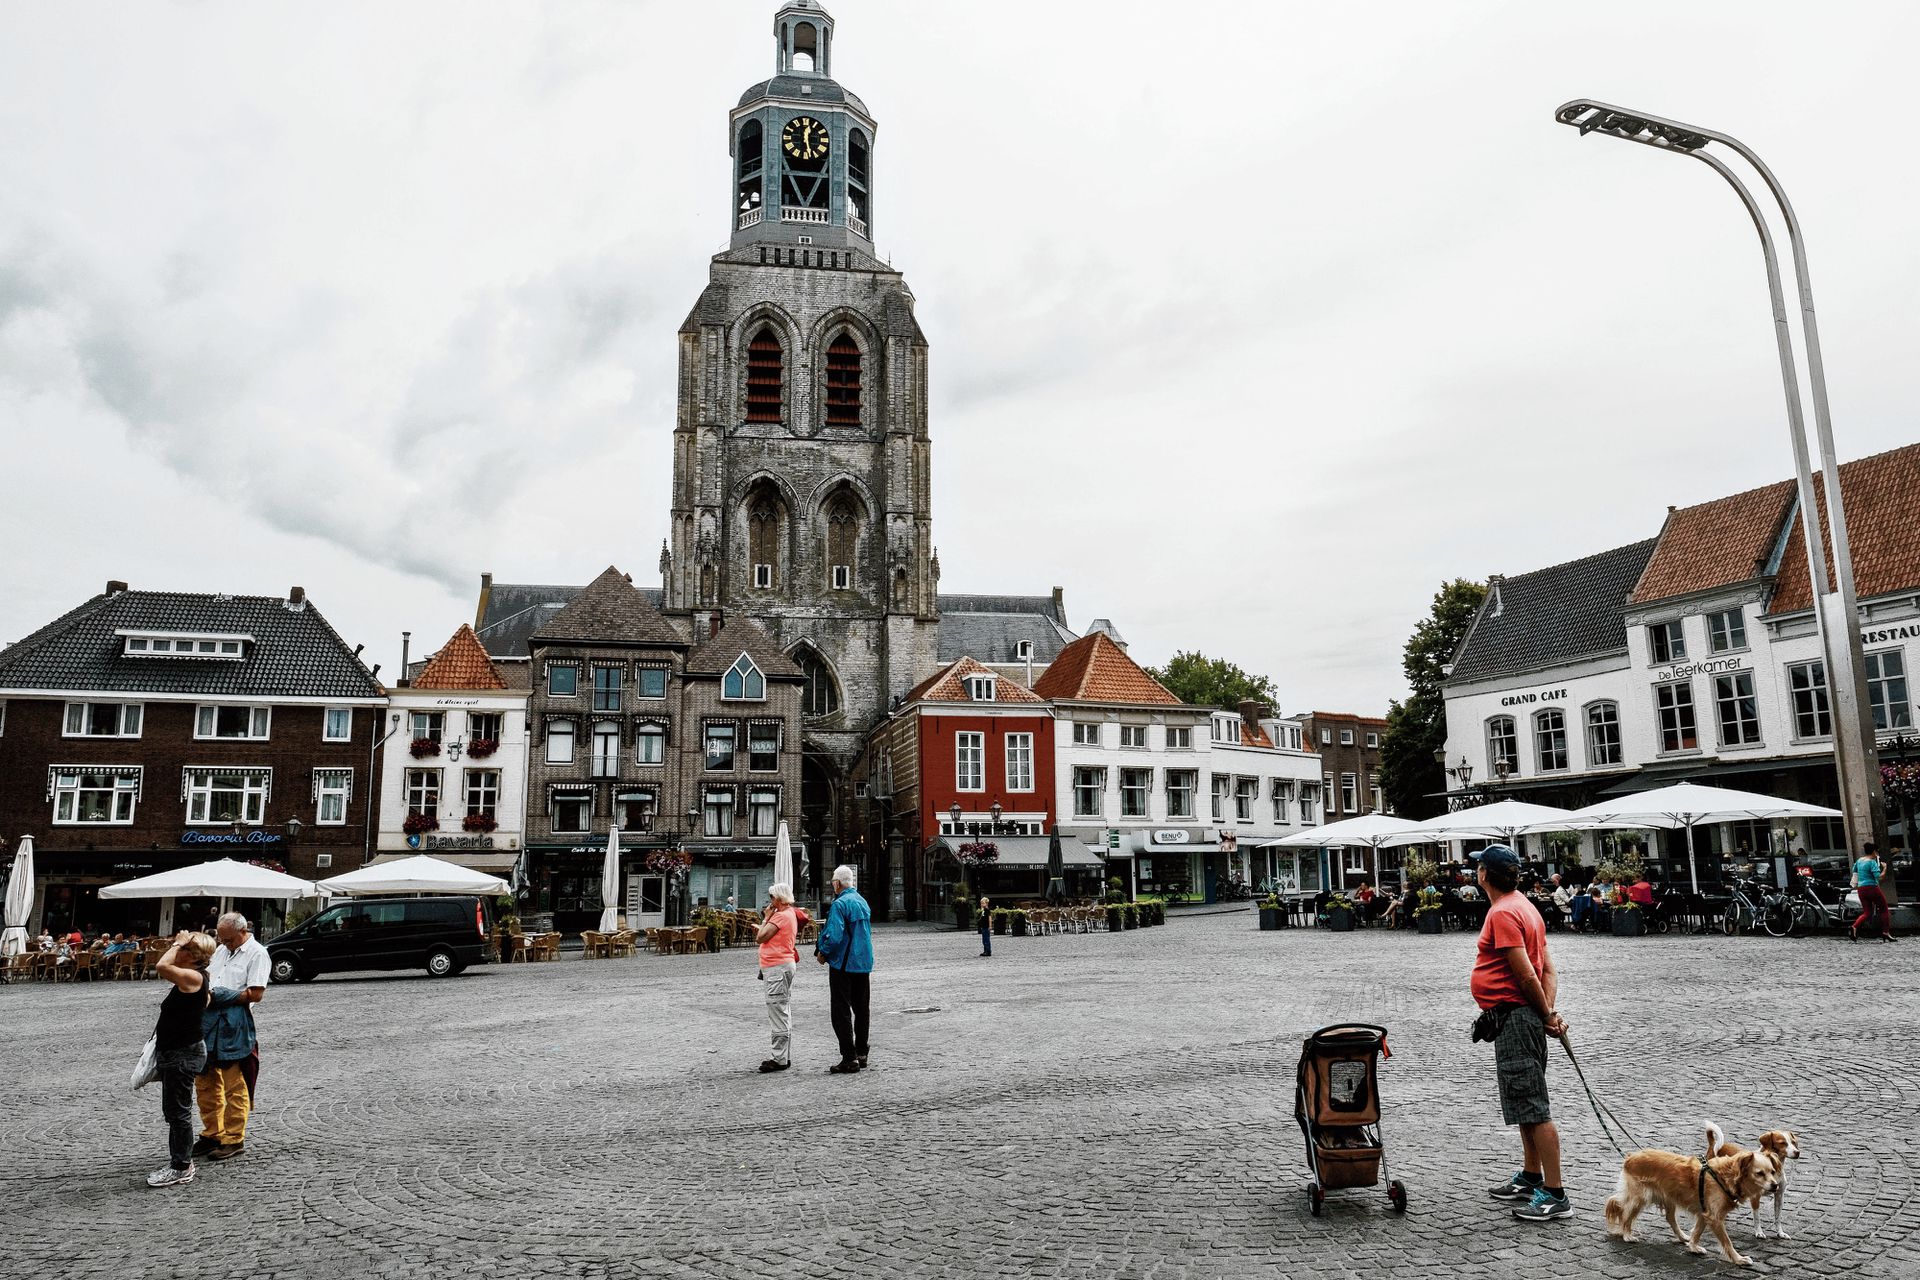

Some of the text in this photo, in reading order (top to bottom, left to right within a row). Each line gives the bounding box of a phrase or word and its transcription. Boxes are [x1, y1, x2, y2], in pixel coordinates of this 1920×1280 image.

[1860, 624, 1920, 644] RESTAU
[1658, 658, 1741, 680] De Teerkamer
[1501, 688, 1568, 707] GRAND CAFE
[181, 830, 281, 843] Bavaria Bier
[426, 834, 494, 849] Bavaria
